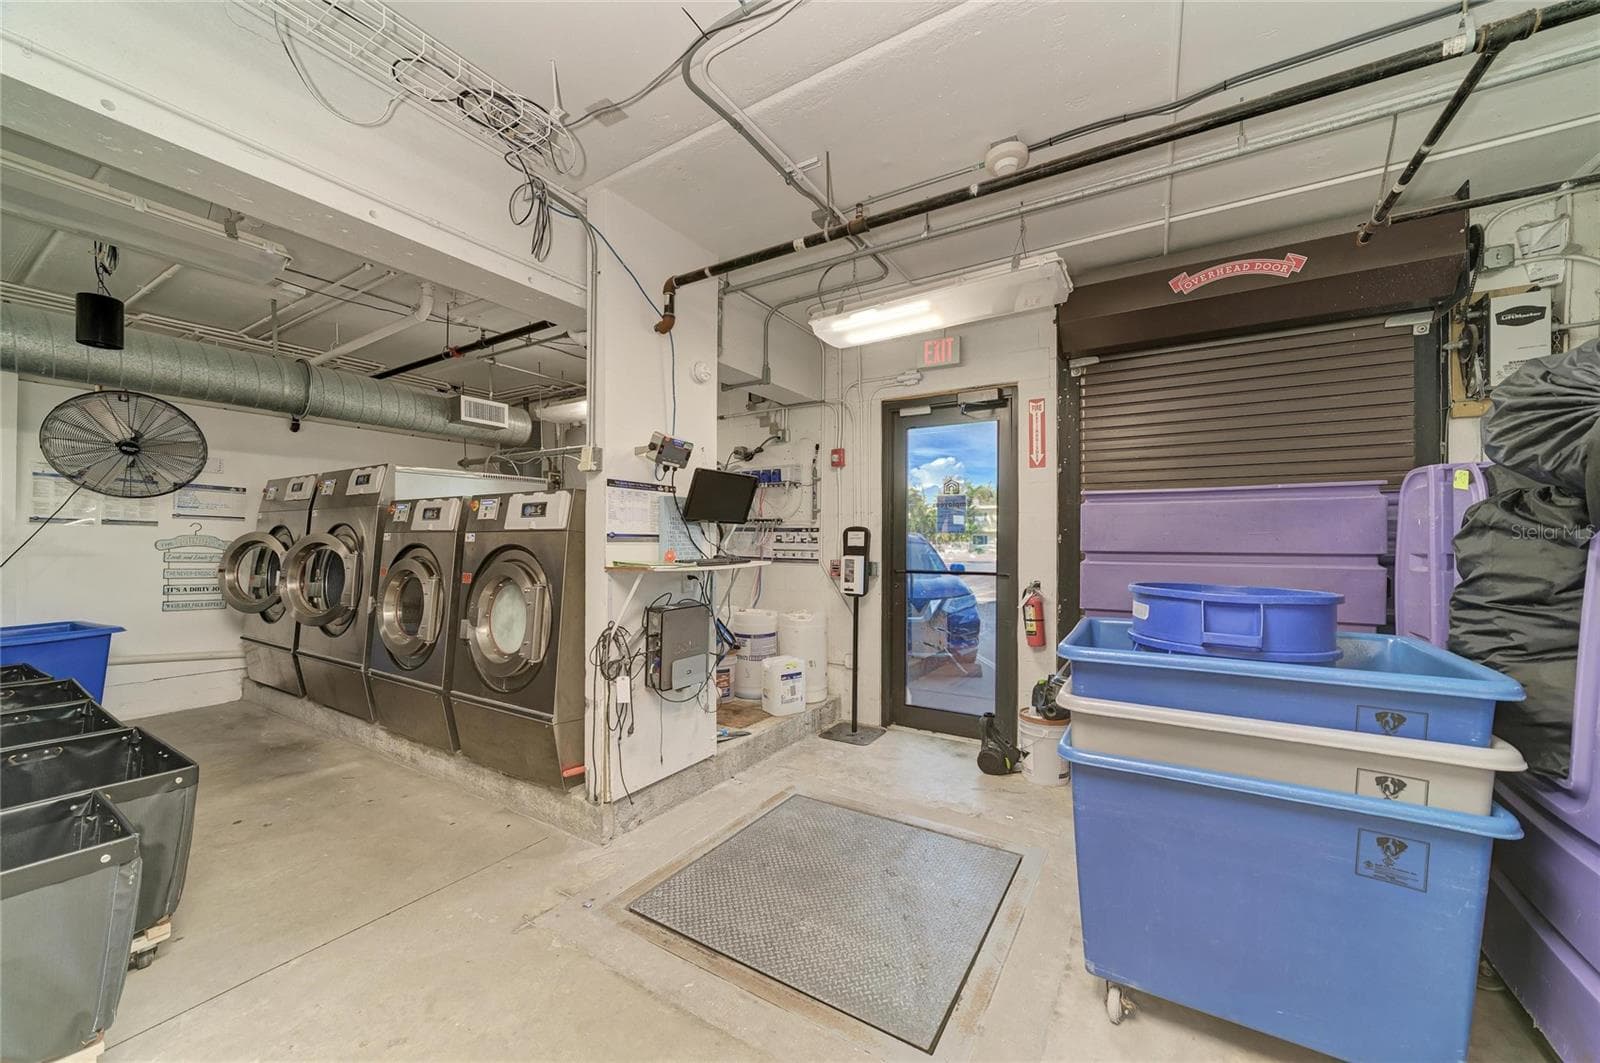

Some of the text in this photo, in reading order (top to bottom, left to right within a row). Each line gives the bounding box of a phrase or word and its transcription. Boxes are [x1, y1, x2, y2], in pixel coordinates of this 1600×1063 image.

[1184, 263, 1289, 289] OVERHEAD DOOR
[1501, 312, 1541, 320] LiftMaster
[924, 337, 953, 365] EXIT
[1031, 404, 1042, 412] FIRE
